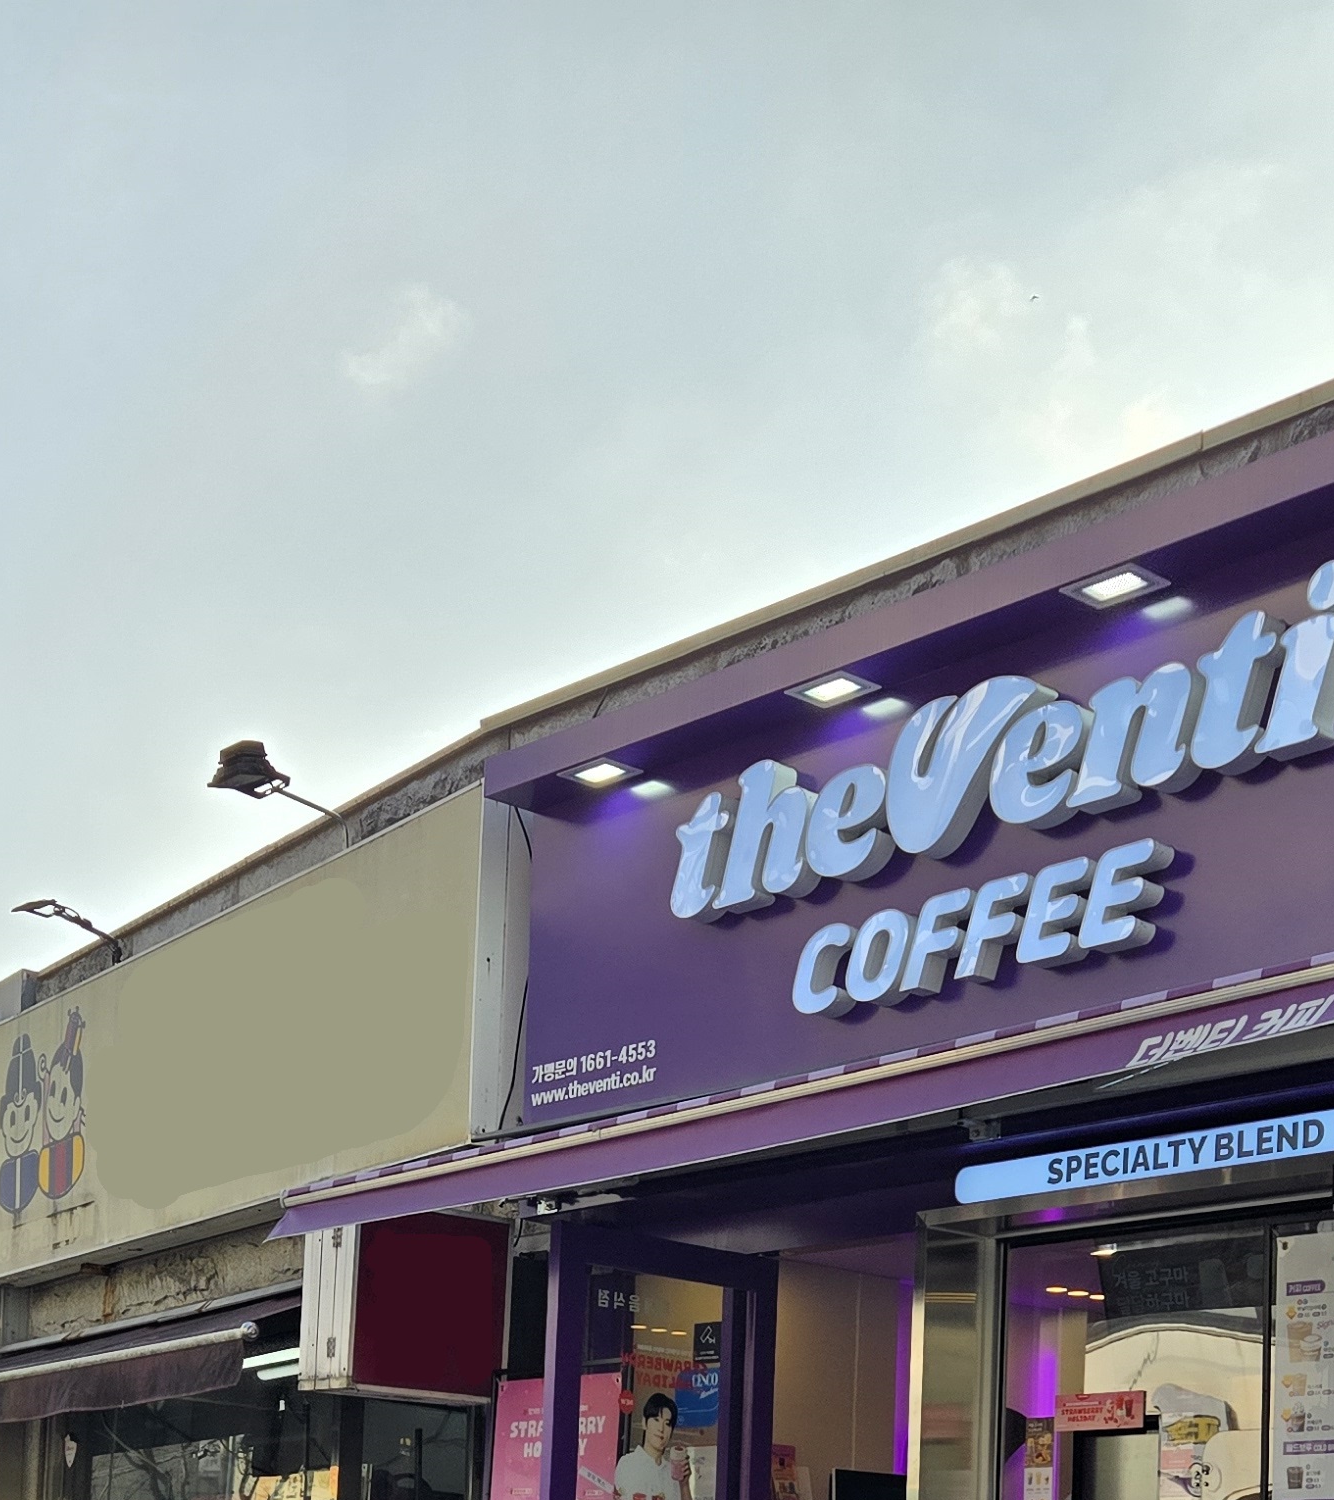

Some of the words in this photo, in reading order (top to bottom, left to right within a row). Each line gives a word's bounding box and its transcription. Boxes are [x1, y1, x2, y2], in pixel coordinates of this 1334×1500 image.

[792, 838, 1175, 1018] COFFEE
[531, 1057, 578, 1084] 가맹문의
[579, 1039, 656, 1074] 1661-4553
[1128, 1013, 1249, 1069] 더벤티
[530, 1064, 657, 1107] www.theventi.co.kr
[1046, 1134, 1209, 1185] SPECIALTY
[1214, 1119, 1325, 1161] BLEND
